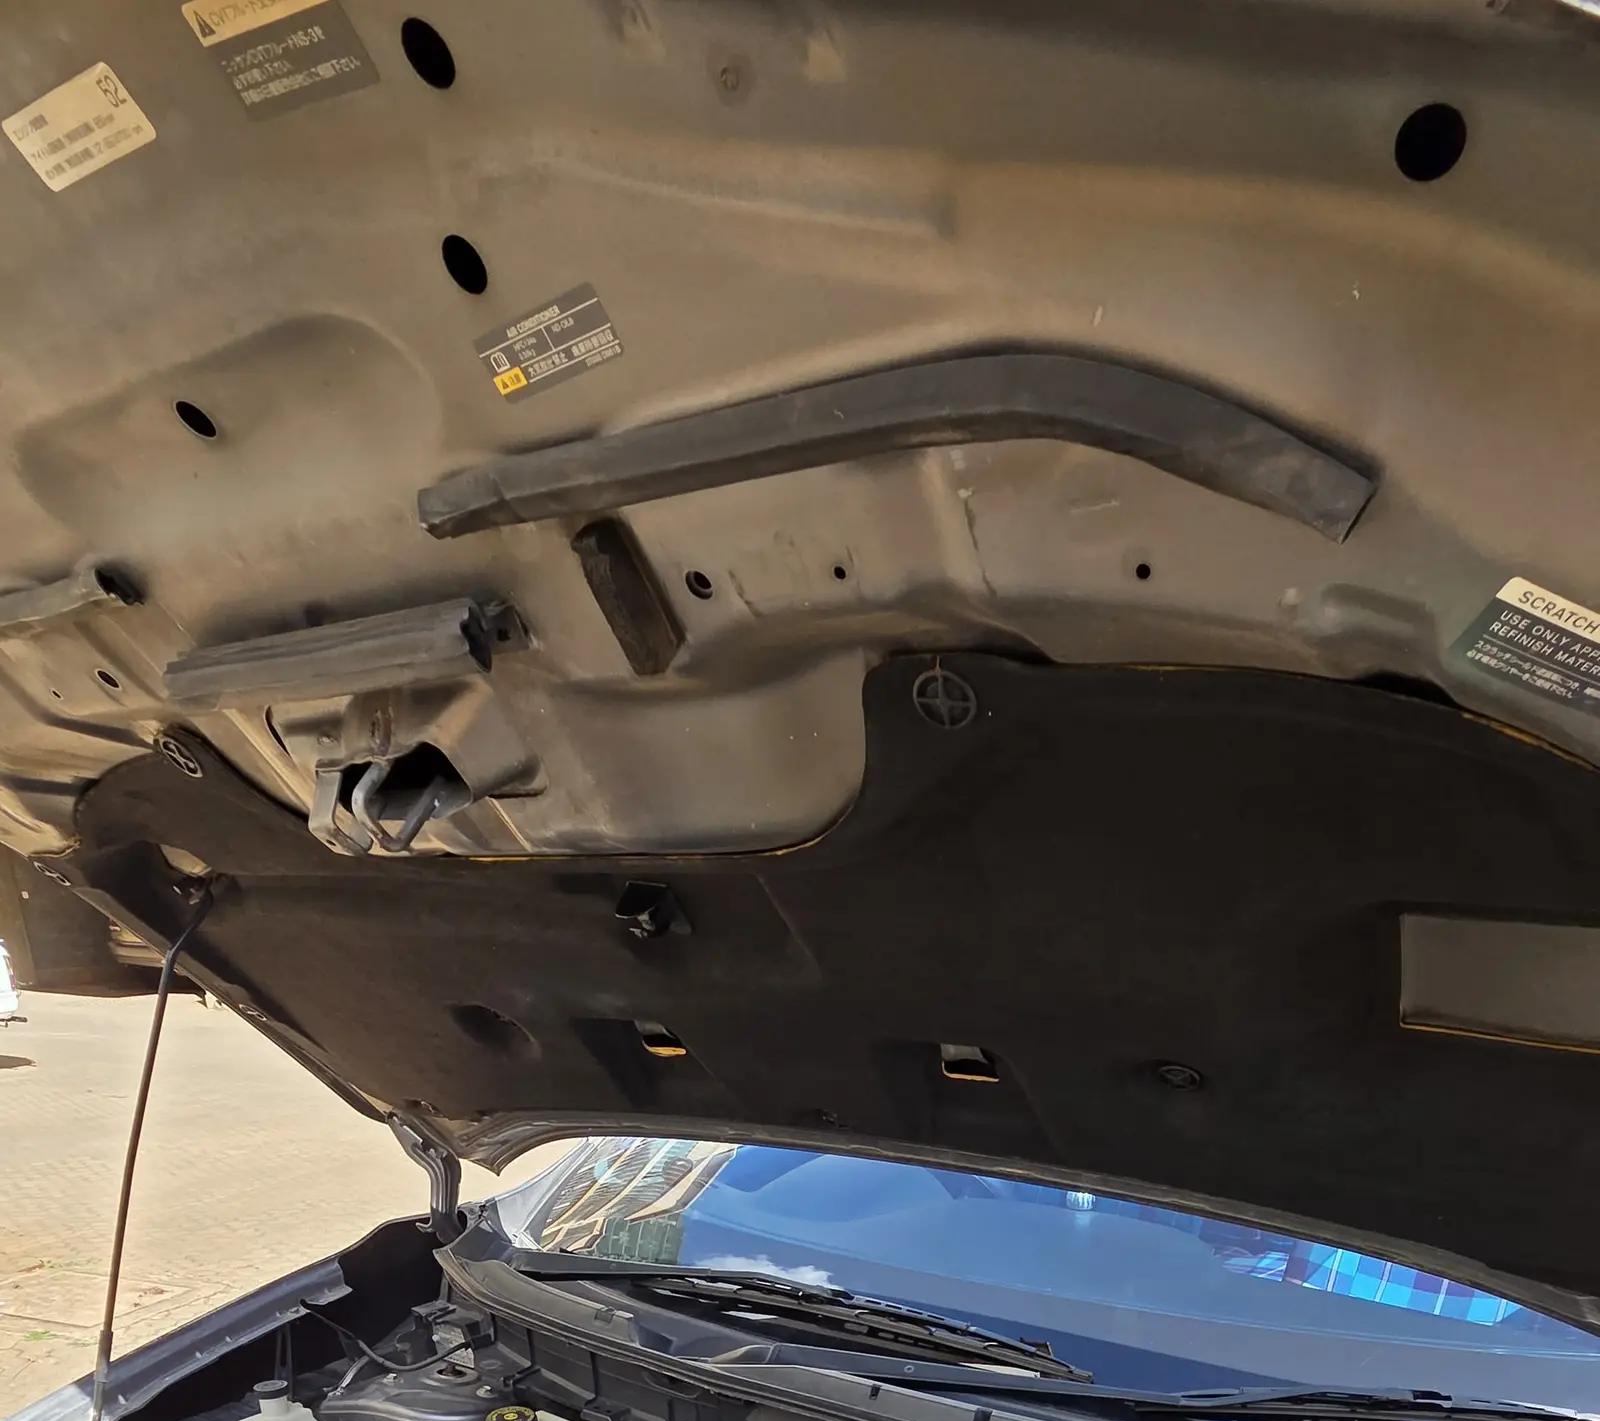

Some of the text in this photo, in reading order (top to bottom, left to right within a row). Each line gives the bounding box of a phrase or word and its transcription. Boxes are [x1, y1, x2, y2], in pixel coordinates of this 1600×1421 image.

[95, 75, 127, 108] 52
[1500, 610, 1532, 630] USE
[1531, 625, 1571, 646] ONLY
[1517, 590, 1600, 635] SCRATCH
[1489, 621, 1600, 677] REFINISH MATER
